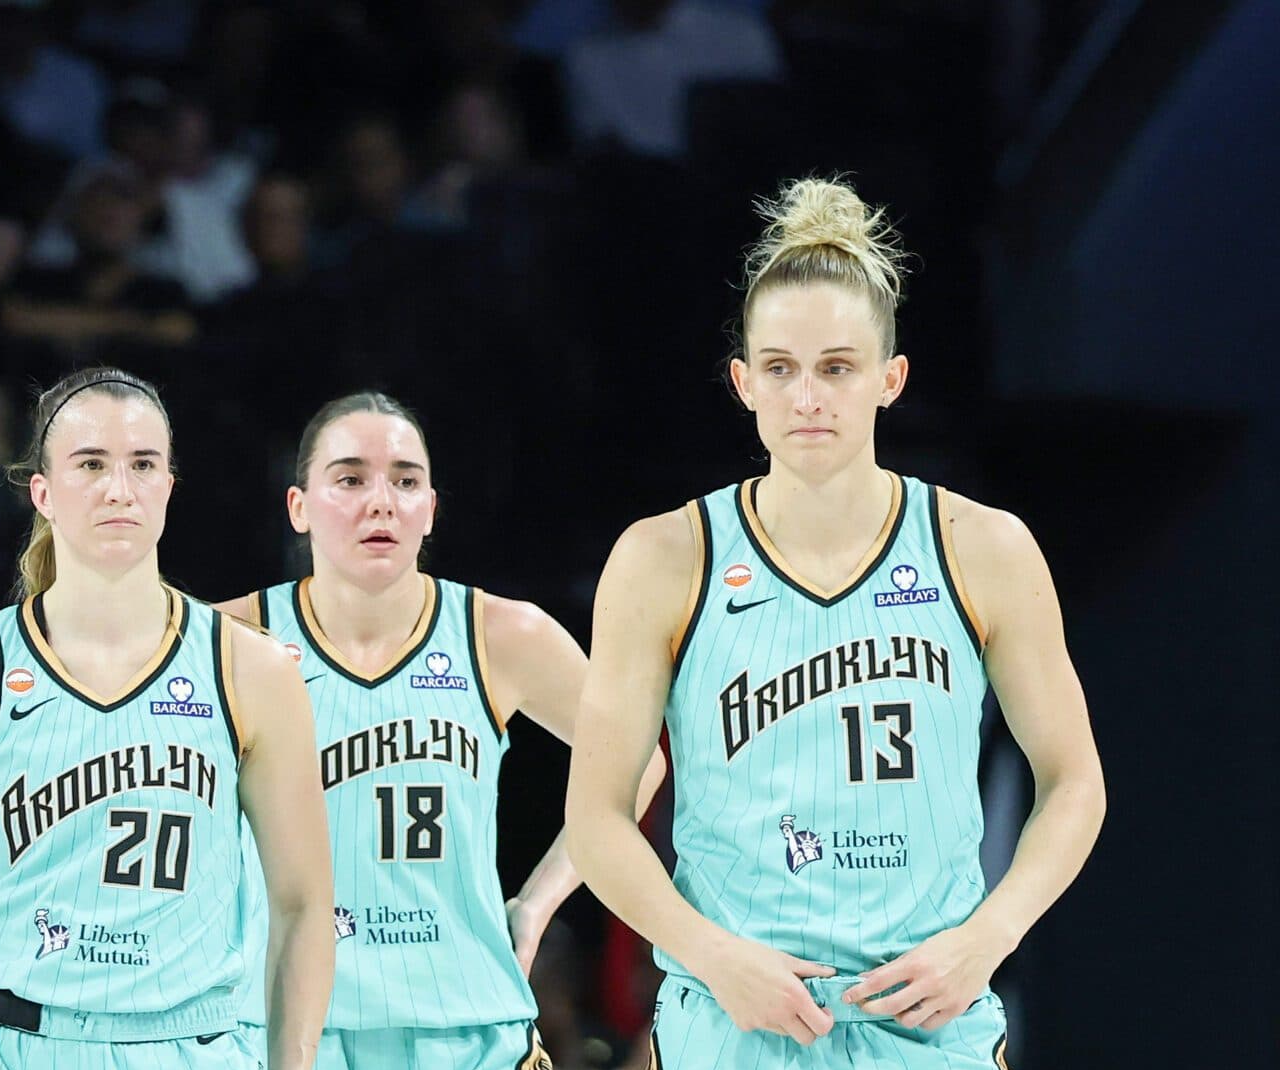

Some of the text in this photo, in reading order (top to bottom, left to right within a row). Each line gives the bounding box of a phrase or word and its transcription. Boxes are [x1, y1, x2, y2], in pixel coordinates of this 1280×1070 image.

[876, 590, 937, 606] BARCLAYS
[411, 675, 467, 690] BARCLAYS
[152, 702, 212, 717] BARCLAYS
[719, 635, 951, 764] BROOKLYN
[320, 718, 480, 791] OOKLYN
[839, 701, 917, 783] 13
[1, 744, 217, 868] BROOKLYN
[374, 783, 446, 864] 18
[102, 808, 193, 892] 20
[832, 830, 908, 854] Liberty
[832, 849, 907, 869] Mutual
[365, 905, 437, 929] Liberty
[78, 923, 150, 952] Liberty
[365, 924, 440, 945] Mutual
